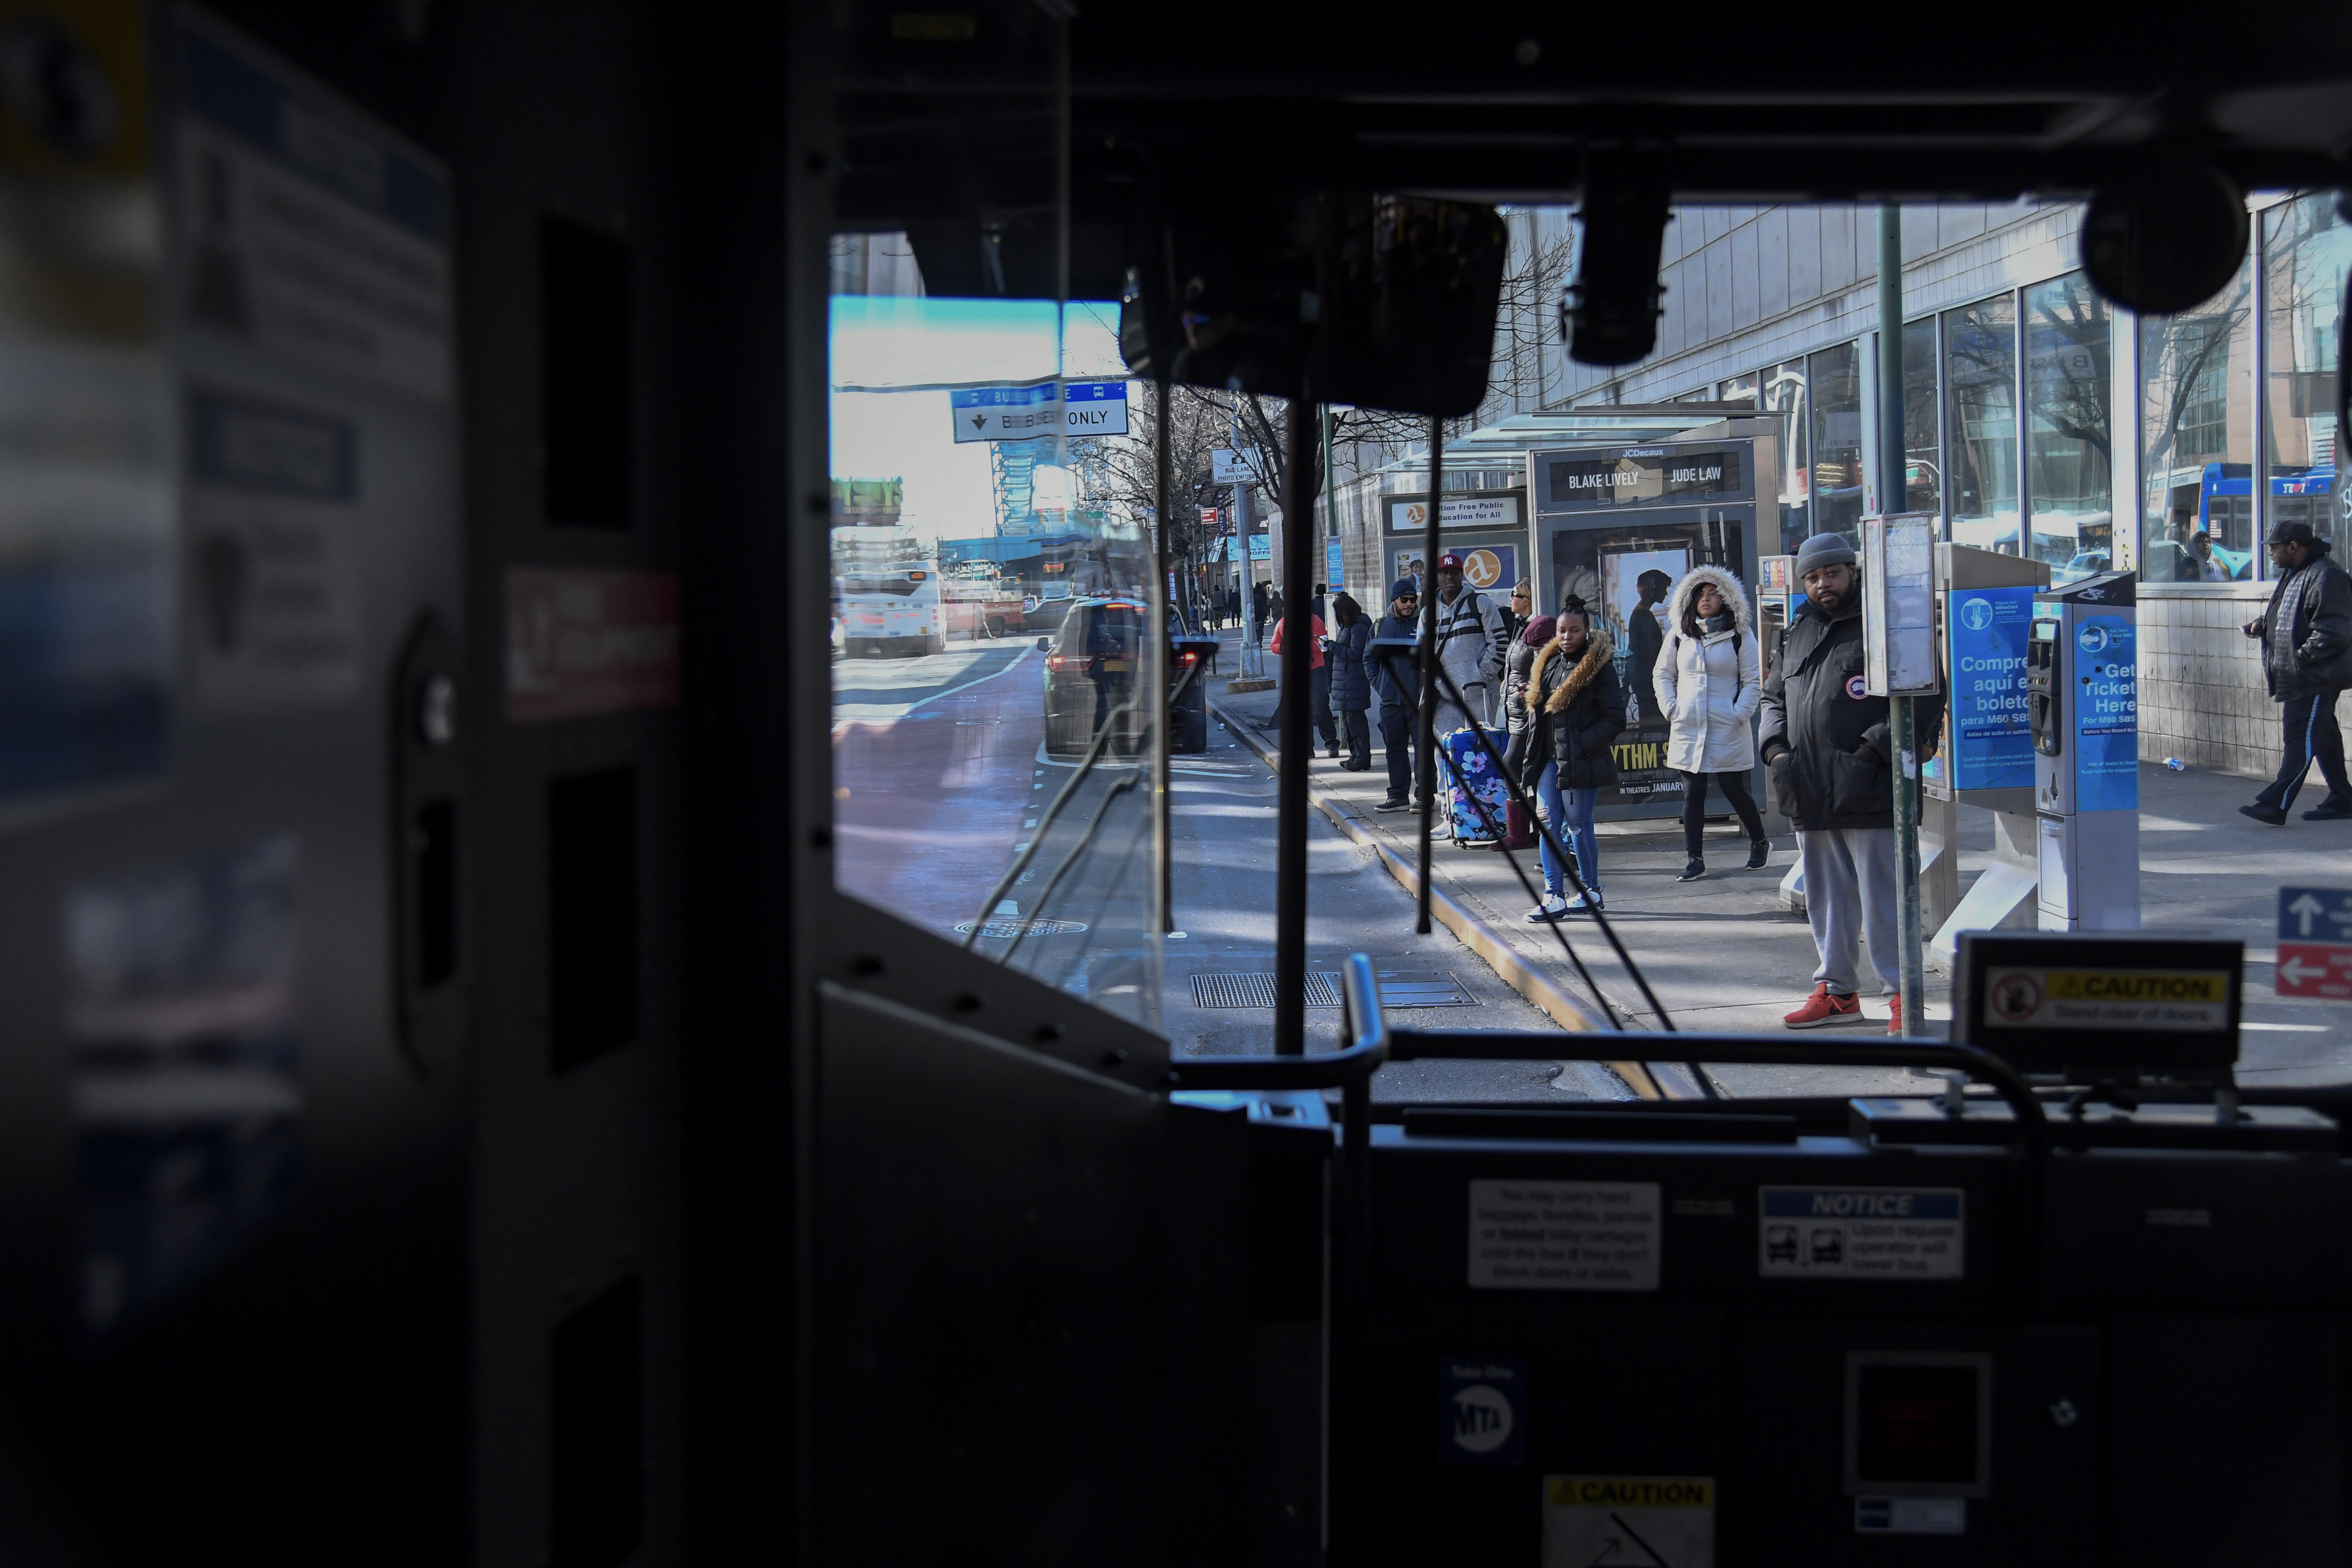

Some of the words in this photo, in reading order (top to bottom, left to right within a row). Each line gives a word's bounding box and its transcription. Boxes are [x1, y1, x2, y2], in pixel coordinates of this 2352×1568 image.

[1068, 410, 1108, 425] ONLY
[1623, 449, 1663, 457] JCDecaux
[1569, 474, 1602, 489] BLAKE
[1606, 472, 1638, 486] LIVELY
[1671, 468, 1696, 483] JUDE
[1699, 467, 1721, 481] LAW
[1438, 512, 1473, 521] ducation
[1961, 656, 2028, 673] Compre
[2105, 664, 2135, 678] Get
[1974, 674, 2013, 694] aquí
[2018, 677, 2027, 689] e
[2083, 681, 2135, 696] Ticket
[2095, 699, 2135, 713] Here
[1961, 718, 1984, 728] para
[1987, 715, 2009, 724] M60
[1652, 782, 1684, 792] JANUARY
[2085, 977, 2209, 997] CAUTION
[2054, 1005, 2099, 1019] Stand
[2102, 1005, 2139, 1019] clear
[2143, 1005, 2162, 1019] of
[1499, 1189, 1523, 1201] You
[1526, 1190, 1555, 1204] may
[1811, 1194, 1914, 1215] NOTICE
[1499, 1227, 1544, 1241] folded
[1852, 1223, 1893, 1238] Upon
[1897, 1225, 1955, 1238] request
[1515, 1247, 1535, 1259] the
[1540, 1248, 1564, 1260] bus
[1851, 1241, 1916, 1255] operator
[1921, 1241, 1948, 1254] will
[1852, 1257, 1893, 1270] lower
[1451, 1365, 1483, 1379] Take
[1455, 1401, 1501, 1435] MTA
[1581, 1483, 1704, 1502] CAUTION
